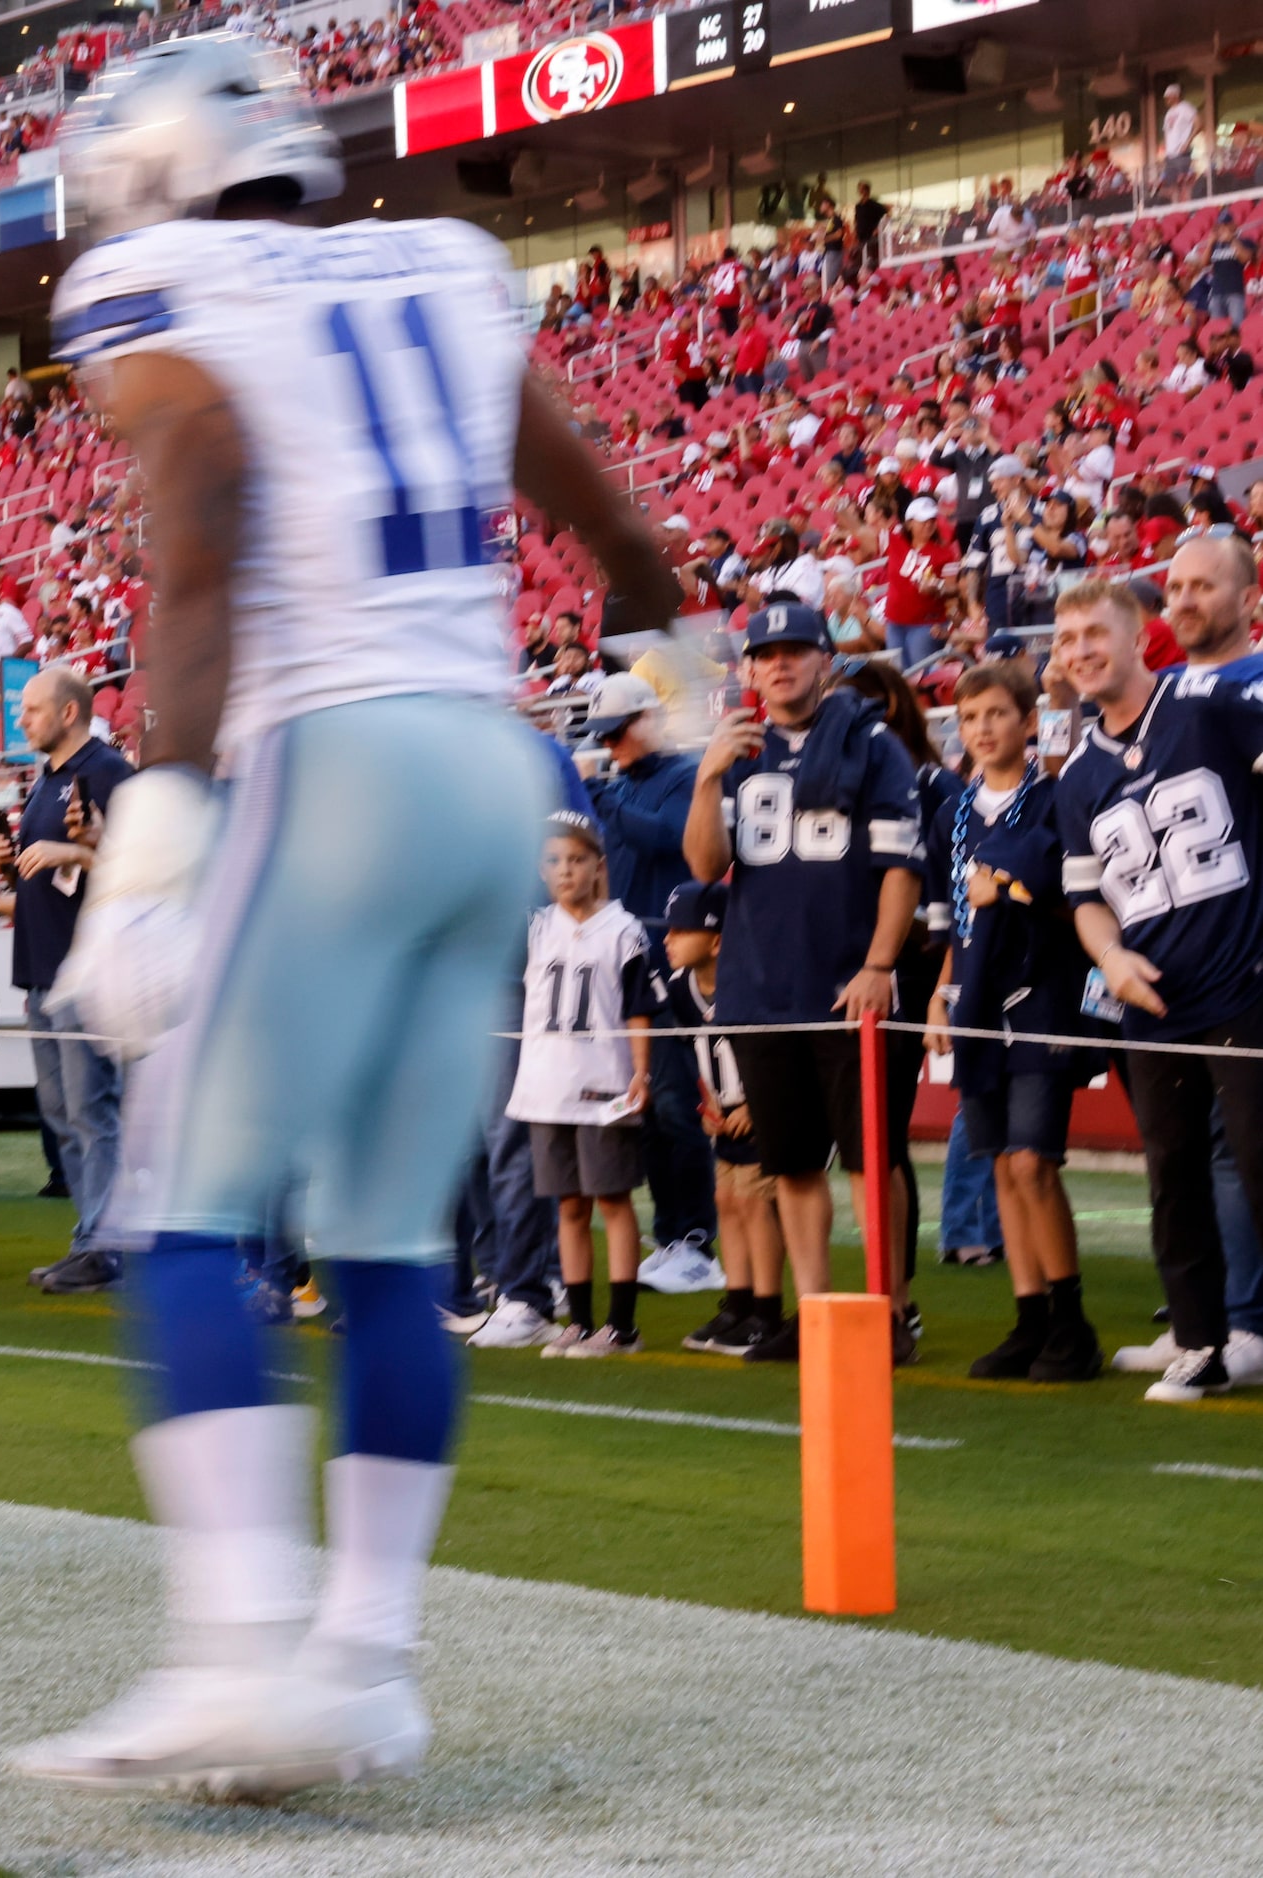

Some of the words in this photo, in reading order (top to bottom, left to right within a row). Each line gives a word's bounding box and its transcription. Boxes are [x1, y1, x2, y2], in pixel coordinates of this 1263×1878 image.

[699, 14, 722, 40] KC
[743, 3, 763, 29] 27
[743, 27, 765, 54] 20
[1088, 111, 1132, 145] 140
[766, 605, 787, 634] D
[1090, 766, 1250, 930] 22
[546, 958, 598, 1041] 11
